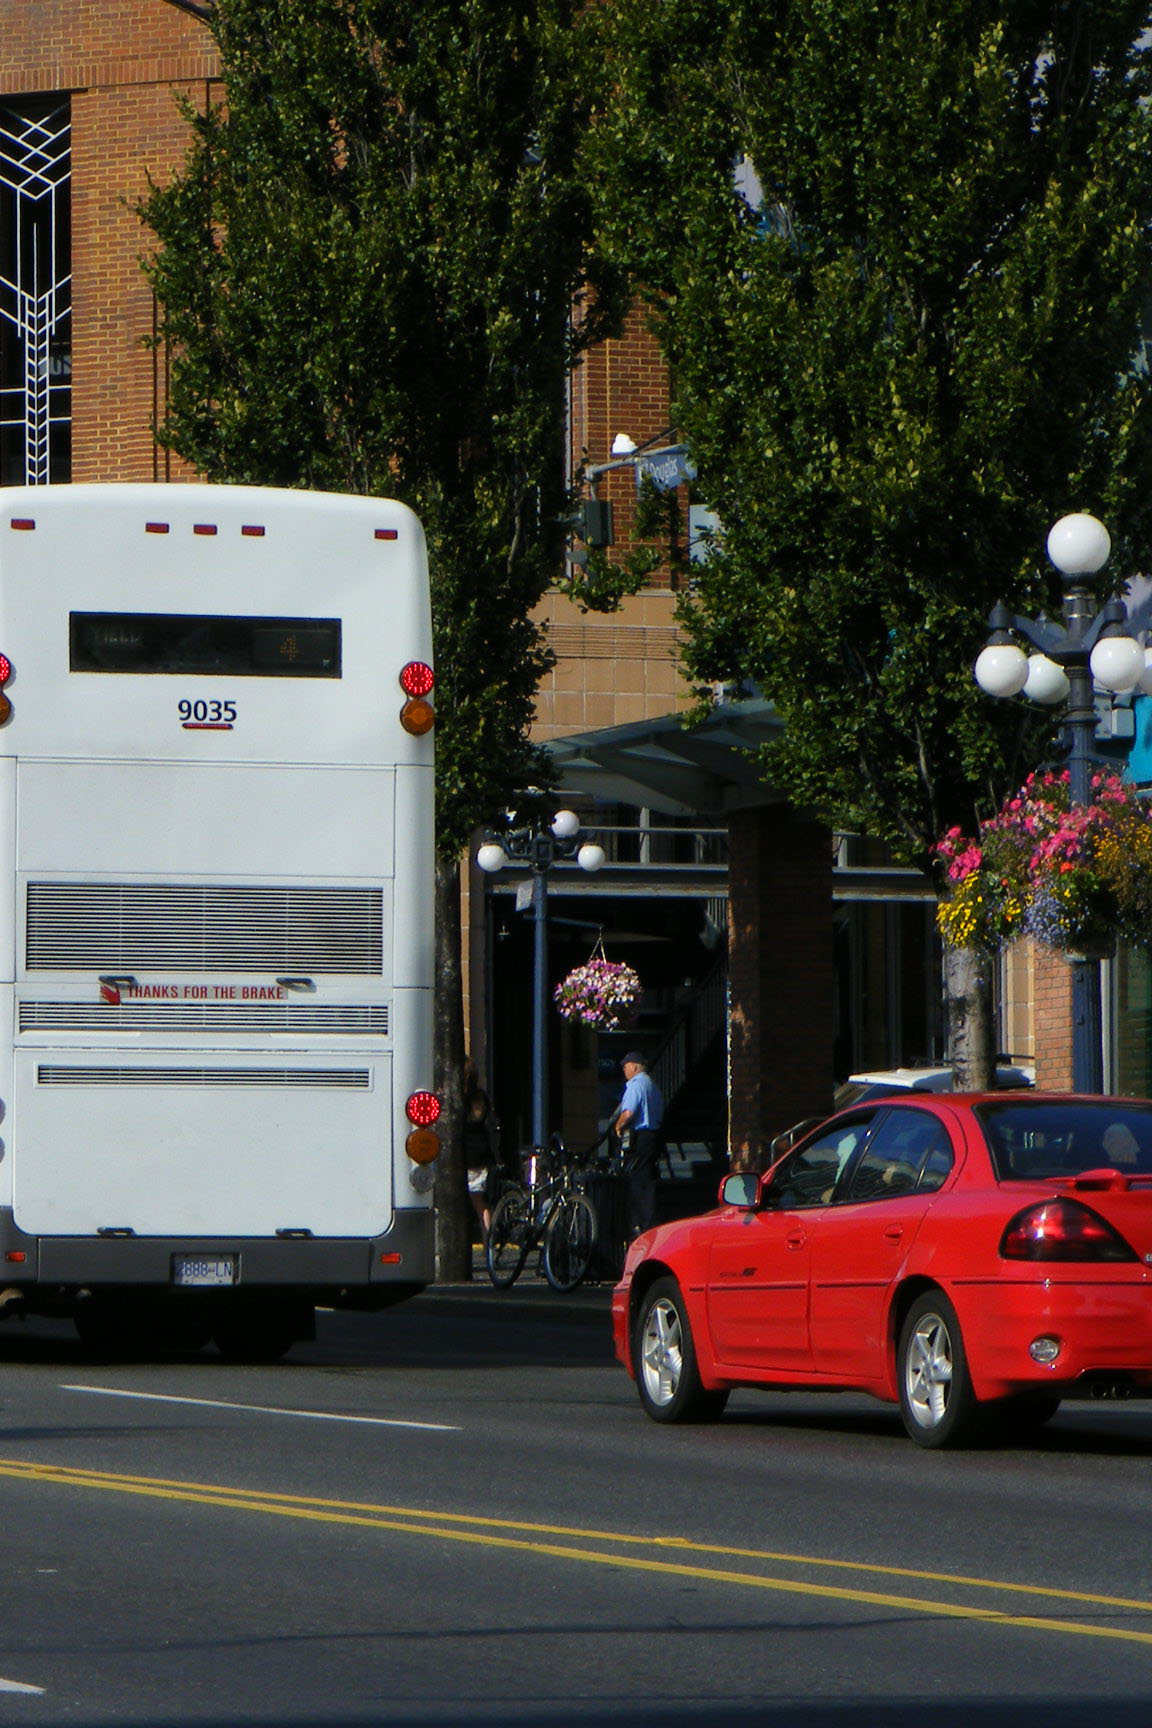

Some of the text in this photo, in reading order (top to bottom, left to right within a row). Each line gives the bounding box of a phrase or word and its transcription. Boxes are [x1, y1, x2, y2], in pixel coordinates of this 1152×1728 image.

[177, 698, 238, 723] 9035
[127, 984, 284, 1001] THANKS FOR THE BRAKE
